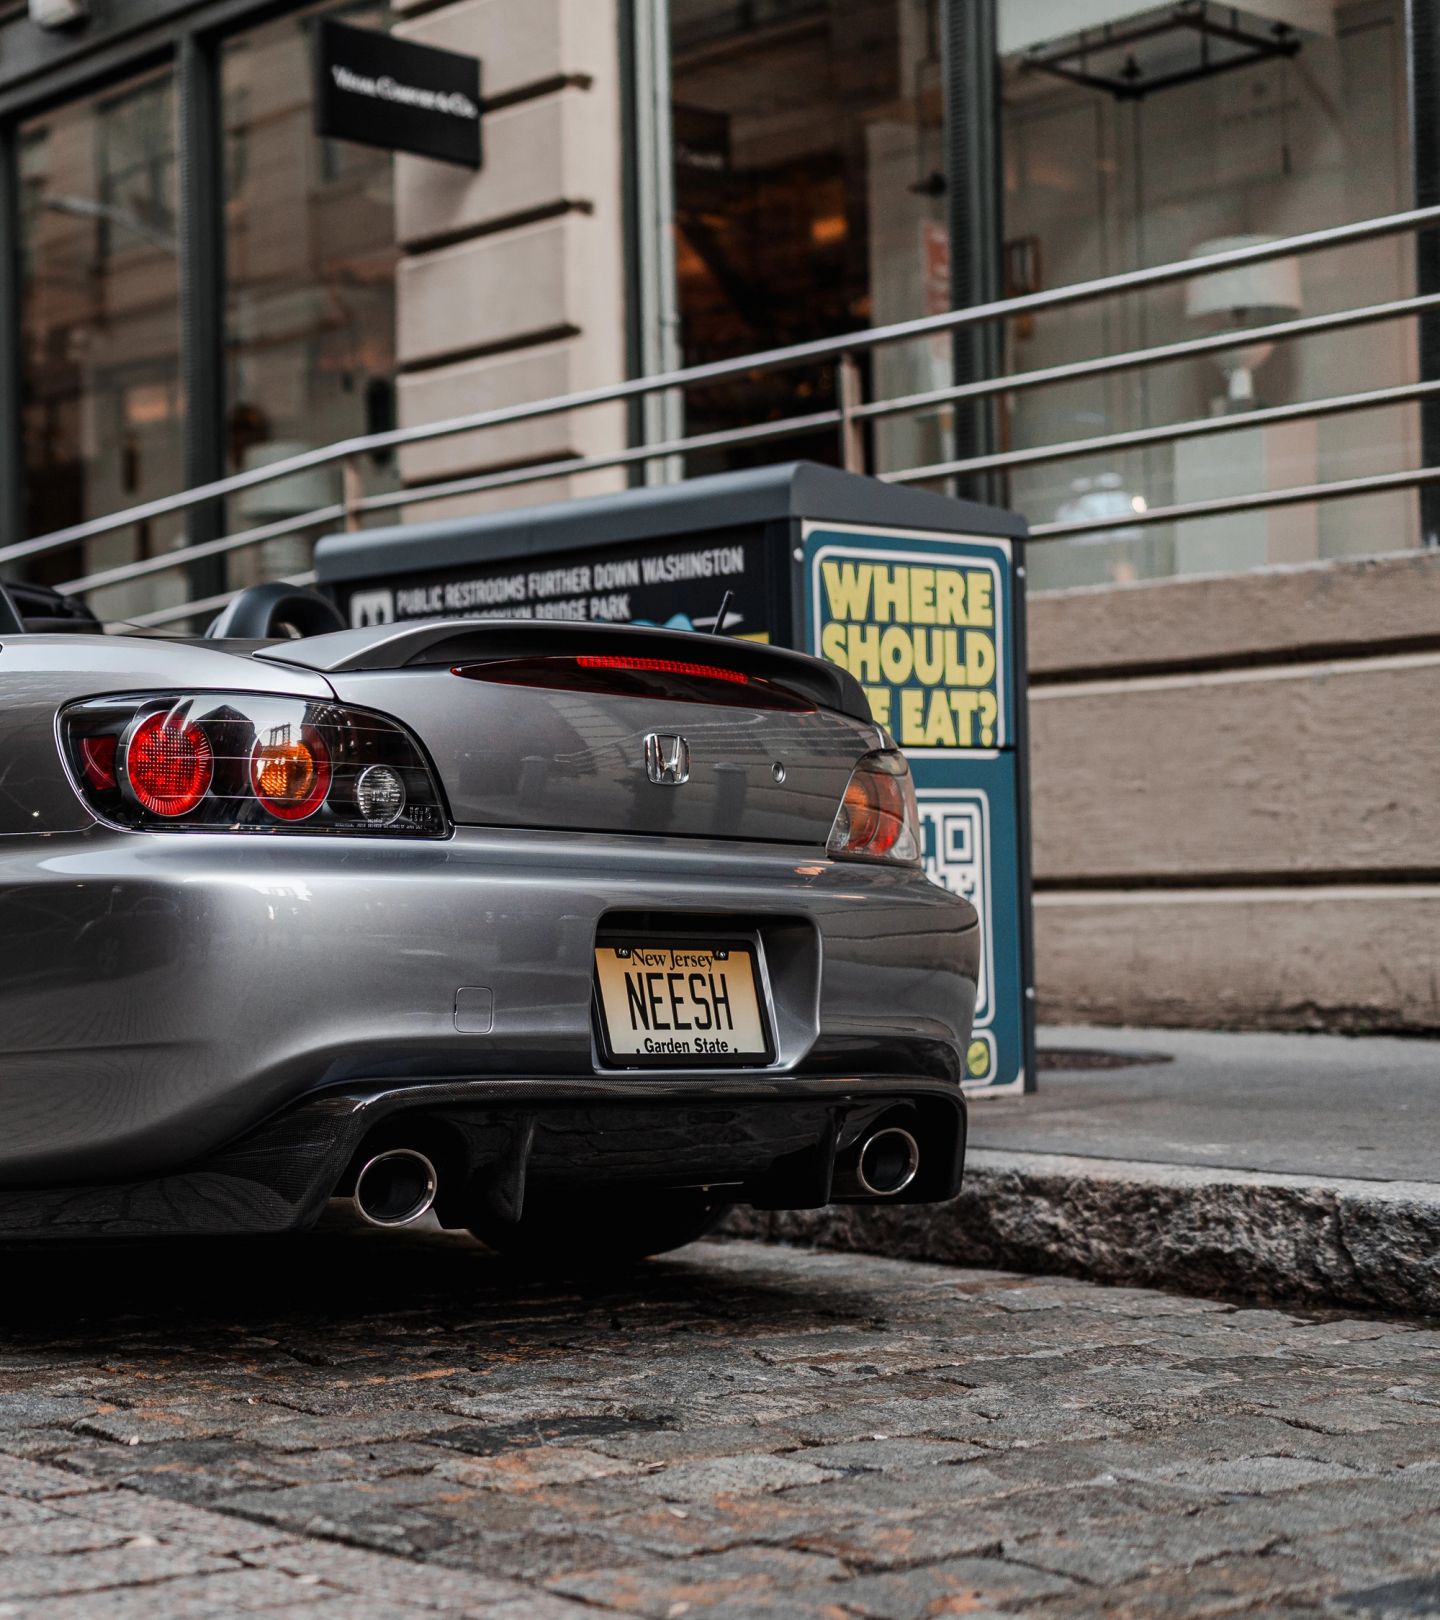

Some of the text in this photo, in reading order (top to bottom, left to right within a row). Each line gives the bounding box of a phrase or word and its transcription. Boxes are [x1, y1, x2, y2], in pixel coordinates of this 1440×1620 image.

[396, 586, 442, 615] PUBLIC
[445, 574, 525, 609] RESTROOMS
[528, 565, 591, 599] FURTHER
[594, 559, 640, 591] DOWN
[642, 545, 744, 584] WASHINGTON
[590, 594, 631, 620] PARK
[822, 560, 994, 627] WHERE
[822, 622, 996, 687] SHOULD
[900, 689, 997, 747] EAT?
[631, 949, 714, 972] New Jersey
[624, 972, 734, 1030] NEESH
[644, 1037, 728, 1053] Garden State
